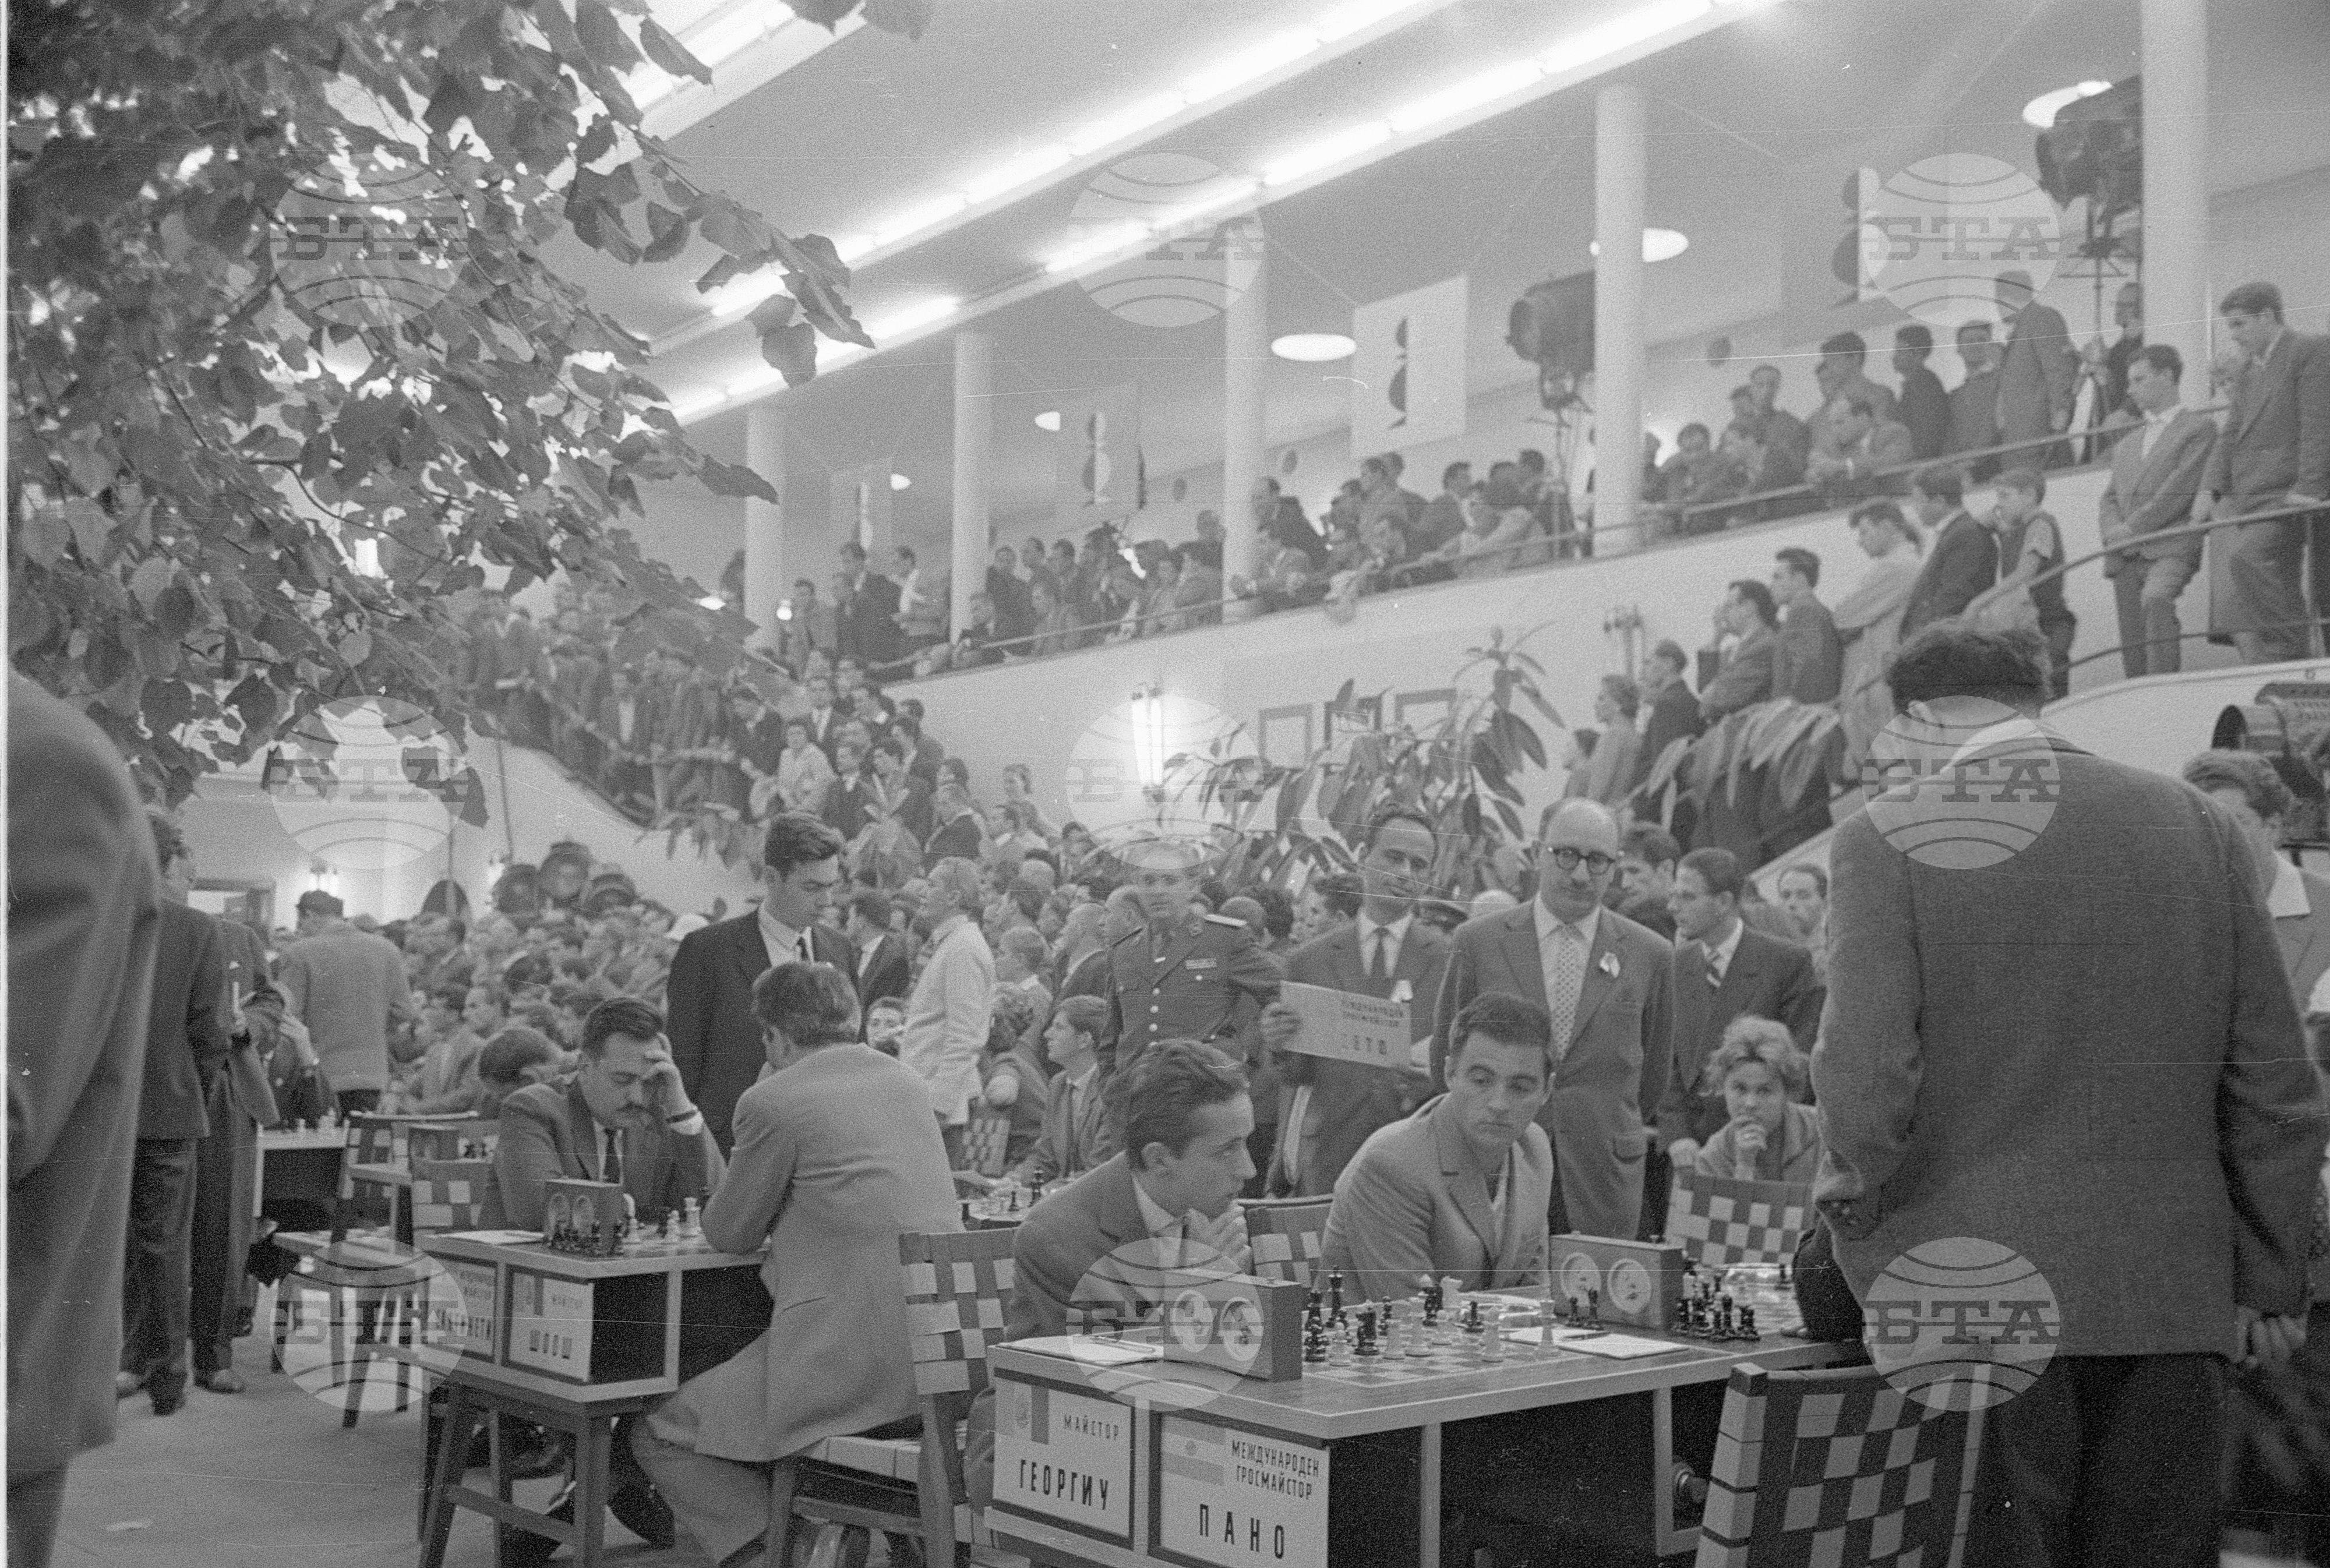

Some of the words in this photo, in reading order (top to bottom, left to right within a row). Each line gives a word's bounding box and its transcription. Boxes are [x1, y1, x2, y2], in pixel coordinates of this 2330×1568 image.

[1064, 1414, 1119, 1441] МАЙСТОР
[1231, 1439, 1319, 1478] МЕЖДУНАРОДЕН
[1020, 1459, 1108, 1510] ГЕОРГИУ
[1236, 1464, 1312, 1500] ГРОСМАЙСТОР
[1199, 1503, 1284, 1559] ПАНО
